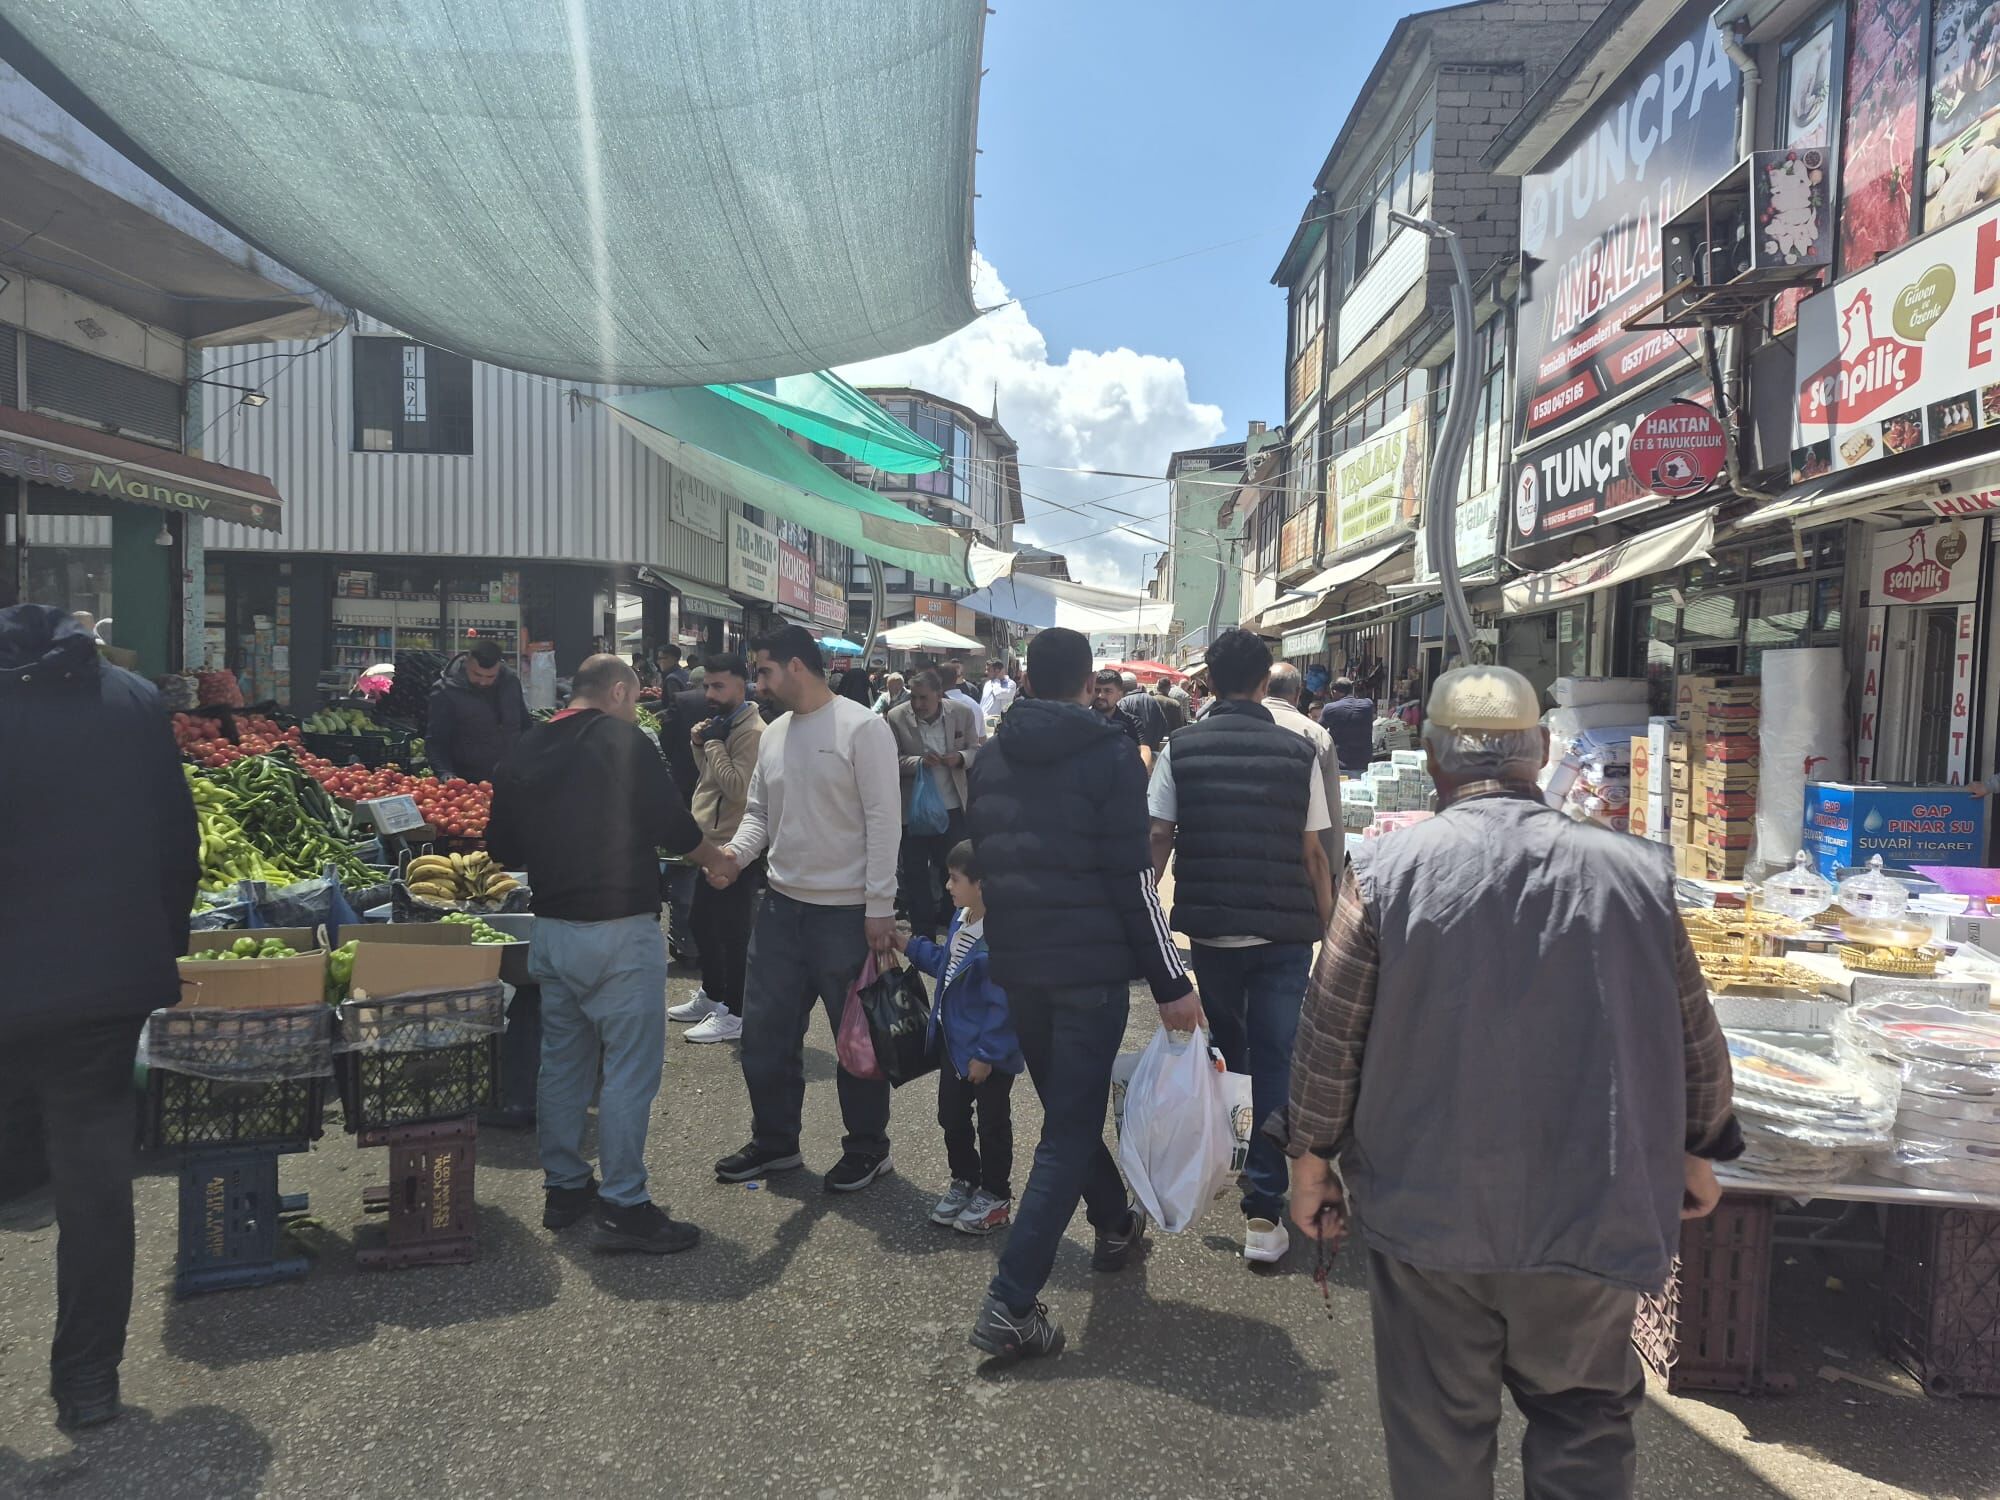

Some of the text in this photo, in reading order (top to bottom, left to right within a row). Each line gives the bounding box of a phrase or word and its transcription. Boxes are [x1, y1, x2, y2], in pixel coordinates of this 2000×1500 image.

[1905, 284, 1936, 307] Güven
[1909, 303, 1942, 328] Özenle
[1810, 343, 1908, 418] şenpiliç
[1646, 416, 1710, 435] HAKTAN
[1633, 434, 1722, 451] ET & TAVUKÇULUK
[1541, 412, 1648, 503] TUNÇP
[90, 465, 211, 512] Manav
[1888, 564, 1943, 593] şenpiliç
[1824, 800, 1841, 813] GAP
[1912, 804, 1952, 818] GAP
[1815, 813, 1849, 831] PINAR SU
[1889, 820, 1975, 834] PINAR SU
[1859, 835, 1974, 850] SUVARİ TİCARET
